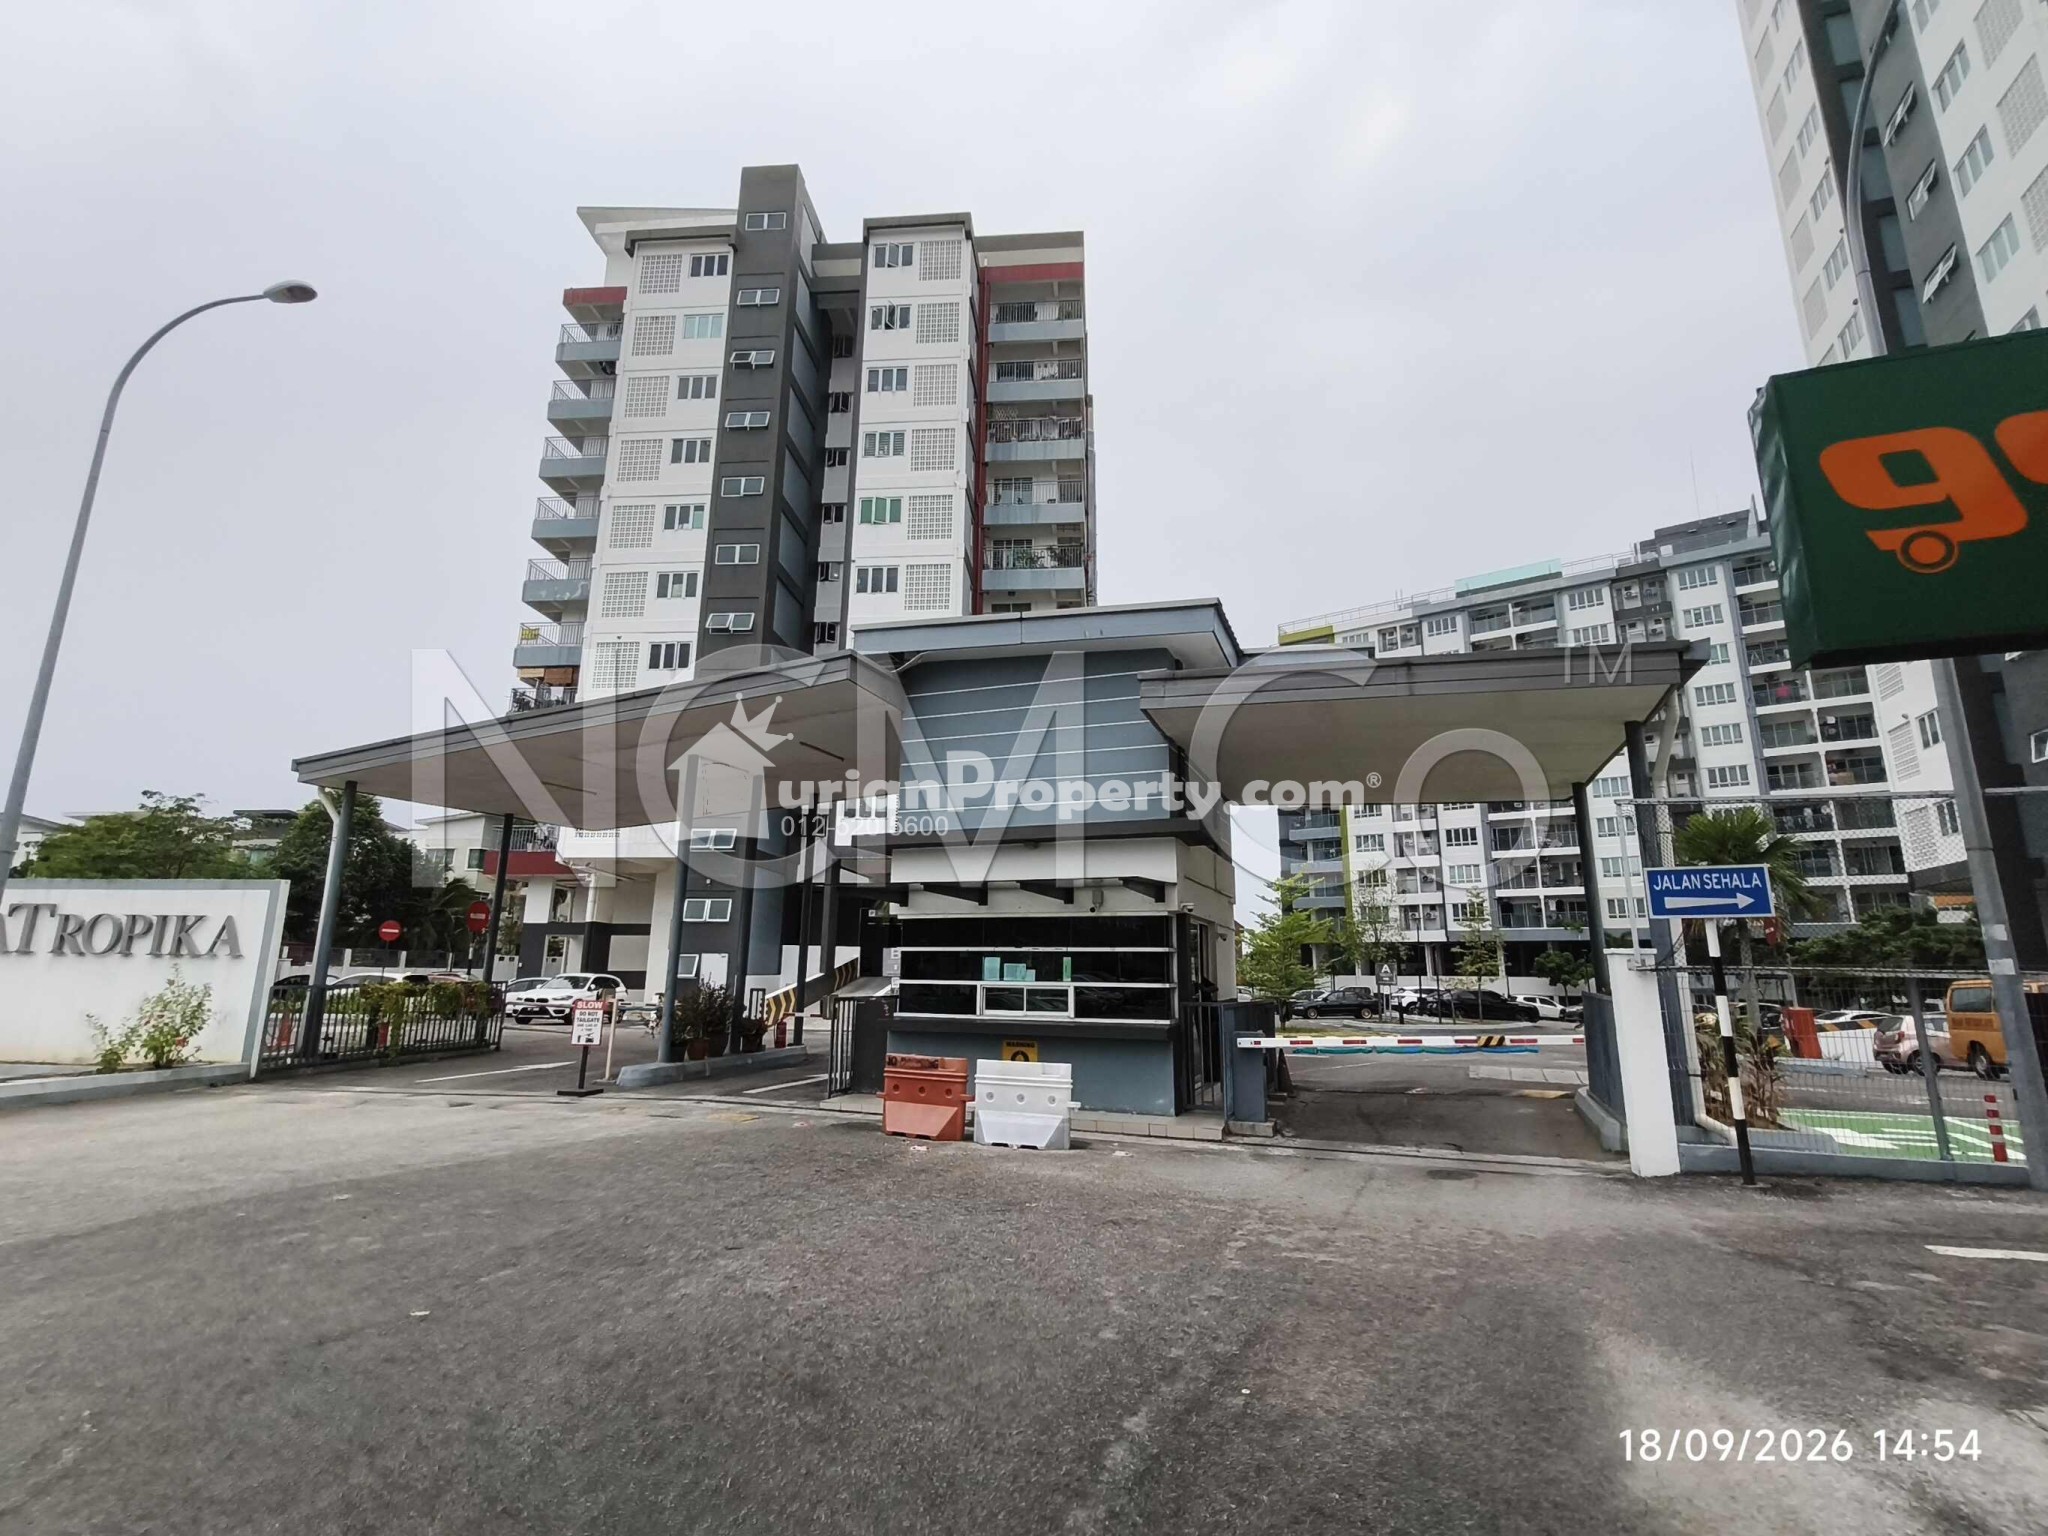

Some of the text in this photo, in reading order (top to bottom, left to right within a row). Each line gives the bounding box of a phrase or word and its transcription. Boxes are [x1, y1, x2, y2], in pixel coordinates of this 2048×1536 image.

[1653, 872, 1762, 890] JALAN SEHALA
[1381, 964, 1391, 973] A
[577, 1001, 603, 1009] SLOW
